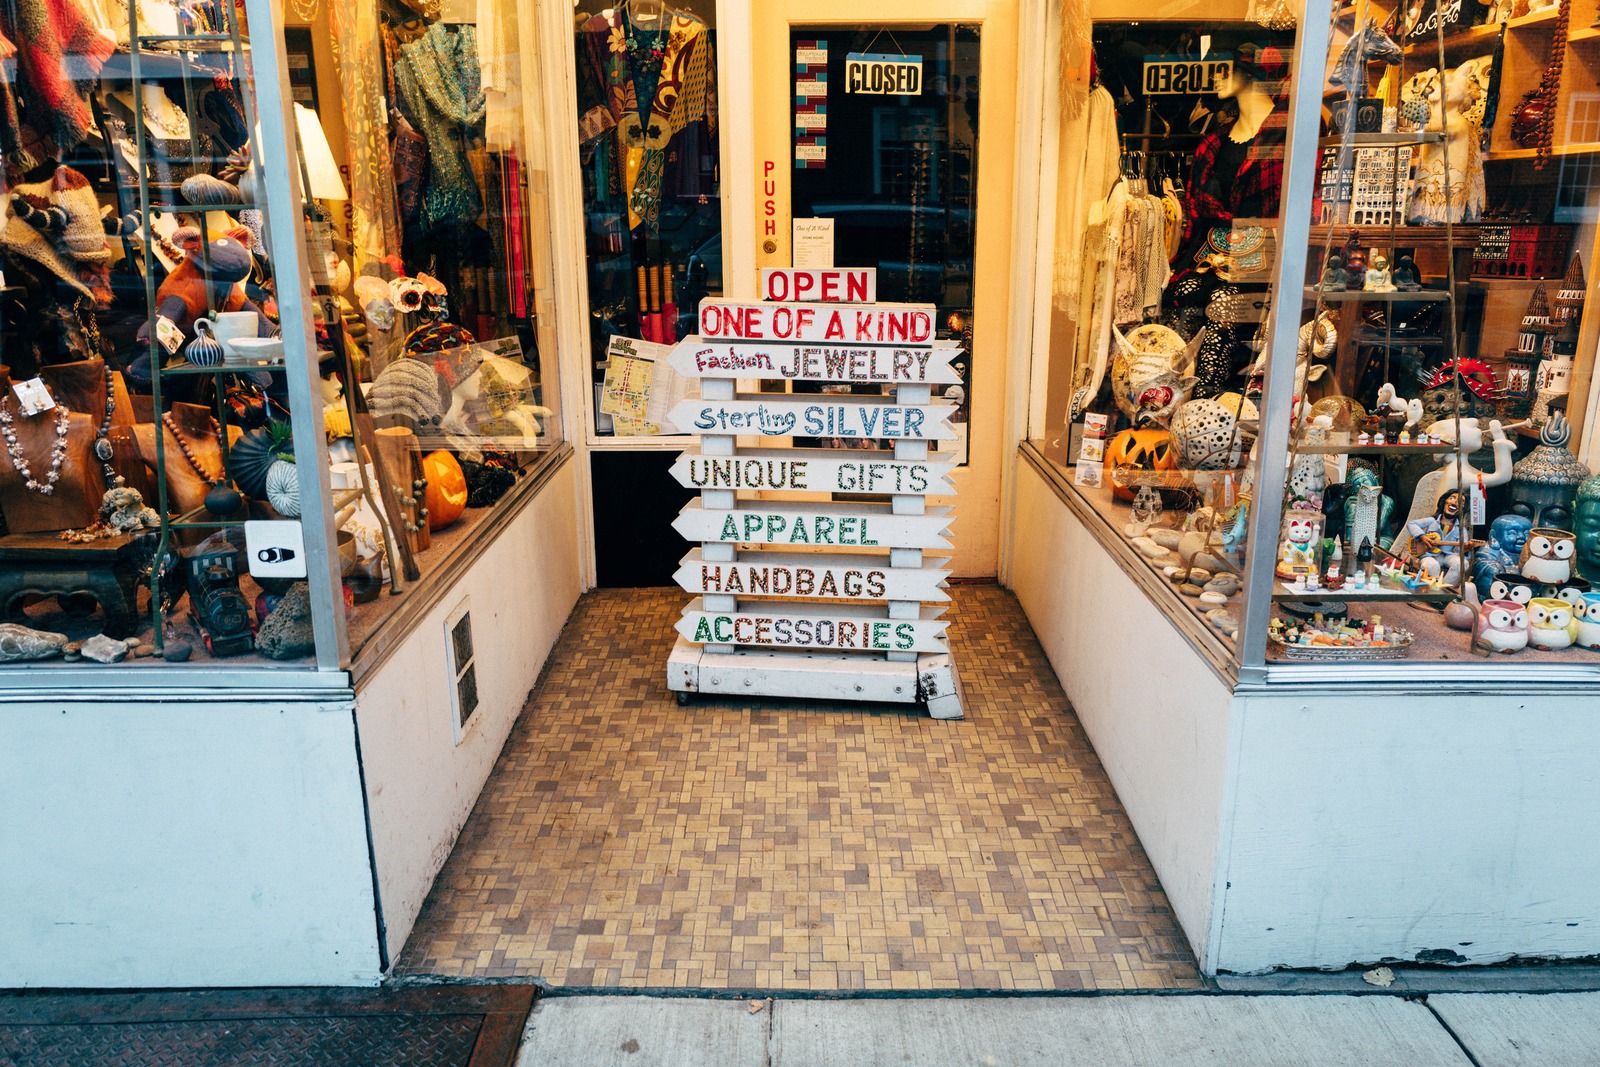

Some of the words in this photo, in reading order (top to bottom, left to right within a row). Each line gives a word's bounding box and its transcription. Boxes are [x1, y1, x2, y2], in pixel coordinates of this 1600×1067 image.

[849, 63, 919, 93] CLOSED
[764, 161, 776, 235] PUSH
[768, 271, 868, 302] OPEN
[702, 305, 763, 339] ONE
[772, 308, 816, 339] OF
[824, 310, 846, 340] A
[856, 311, 931, 342] KIND
[695, 347, 775, 373] Fashion
[780, 348, 932, 381] JEWELRY
[694, 404, 797, 436] Sterling
[804, 406, 925, 438] SILVER
[689, 458, 808, 490] UNIQUE
[837, 463, 928, 492] GIFTS
[719, 513, 879, 546] APPAREL
[701, 565, 886, 598] HANDBAGS
[693, 616, 915, 650] ACCESSORIES
